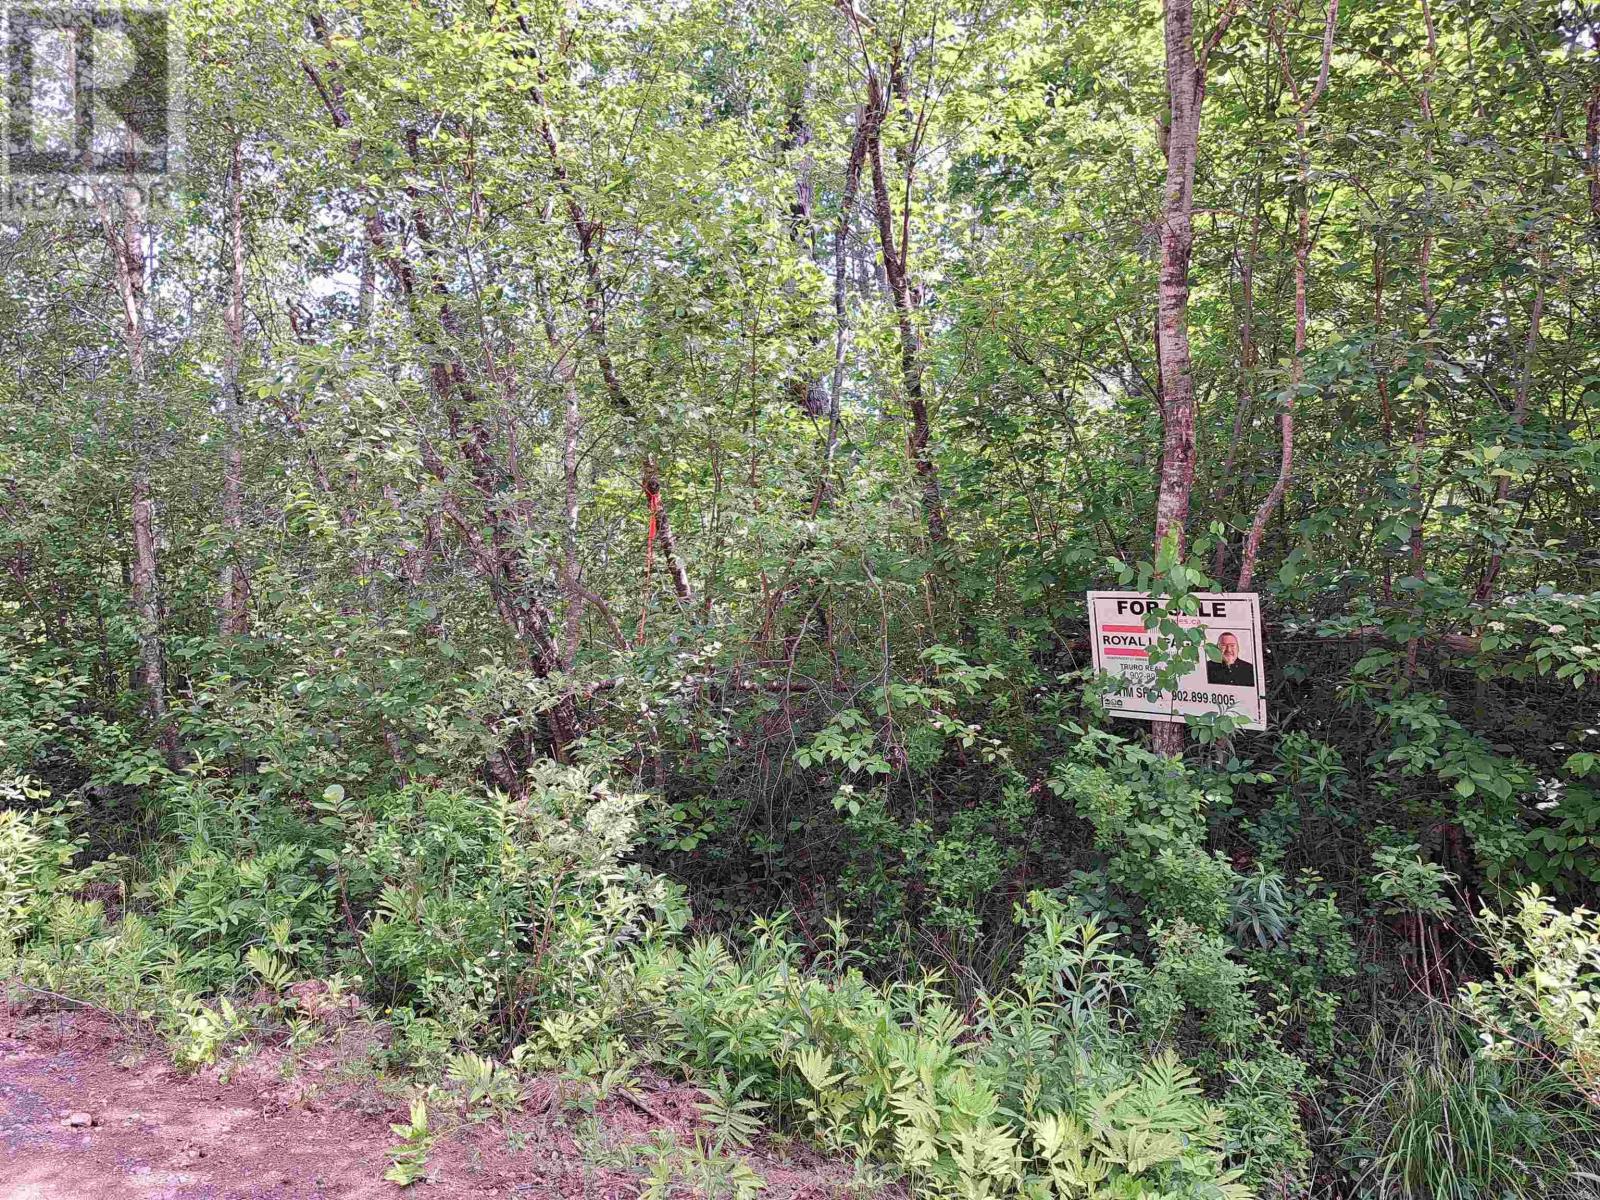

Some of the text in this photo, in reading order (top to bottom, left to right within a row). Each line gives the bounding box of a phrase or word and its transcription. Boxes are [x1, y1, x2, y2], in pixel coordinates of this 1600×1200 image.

[1167, 602, 1227, 618] LE
[1103, 635, 1146, 647] ROYAL
[1120, 663, 1144, 671] TRURO
[1136, 687, 1164, 700] SA
